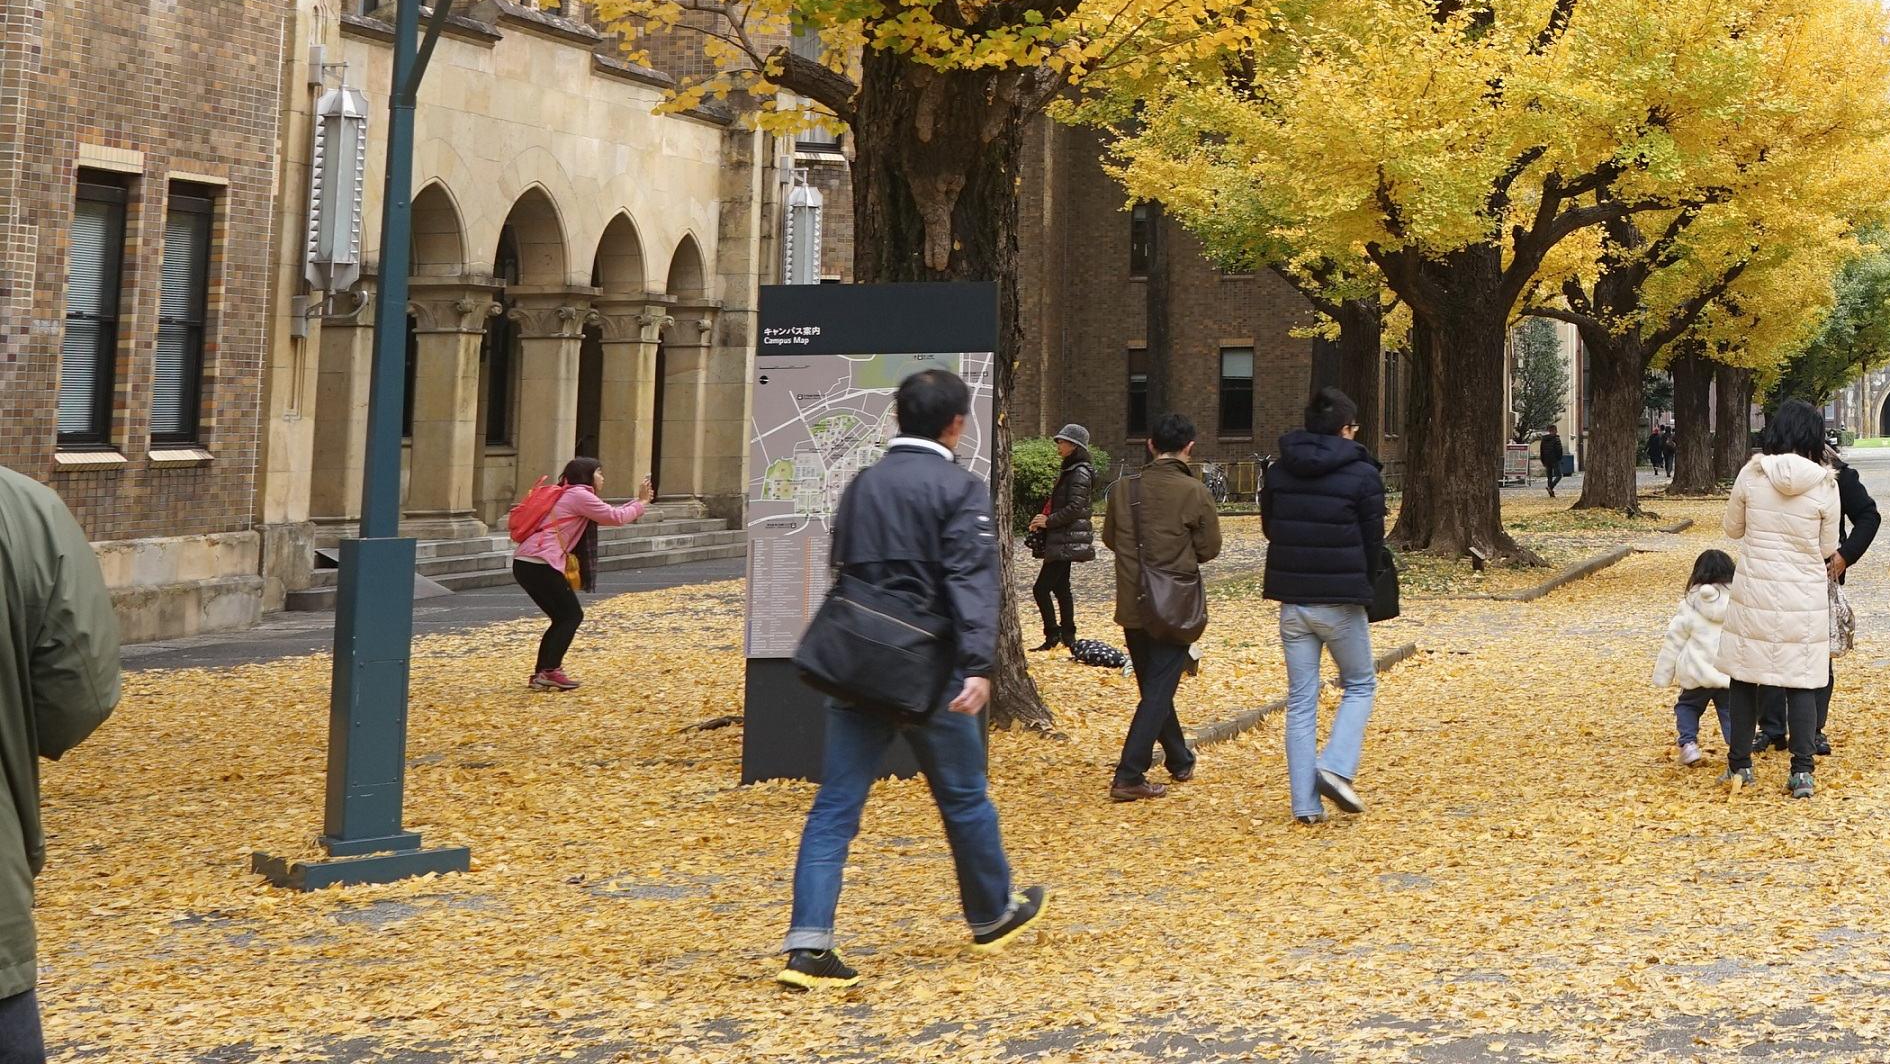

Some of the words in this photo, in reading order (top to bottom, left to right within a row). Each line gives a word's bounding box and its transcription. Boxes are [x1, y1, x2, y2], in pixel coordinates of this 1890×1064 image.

[763, 326, 821, 336] キャンパス案内
[763, 336, 792, 346] Campus
[793, 336, 810, 346] Map
